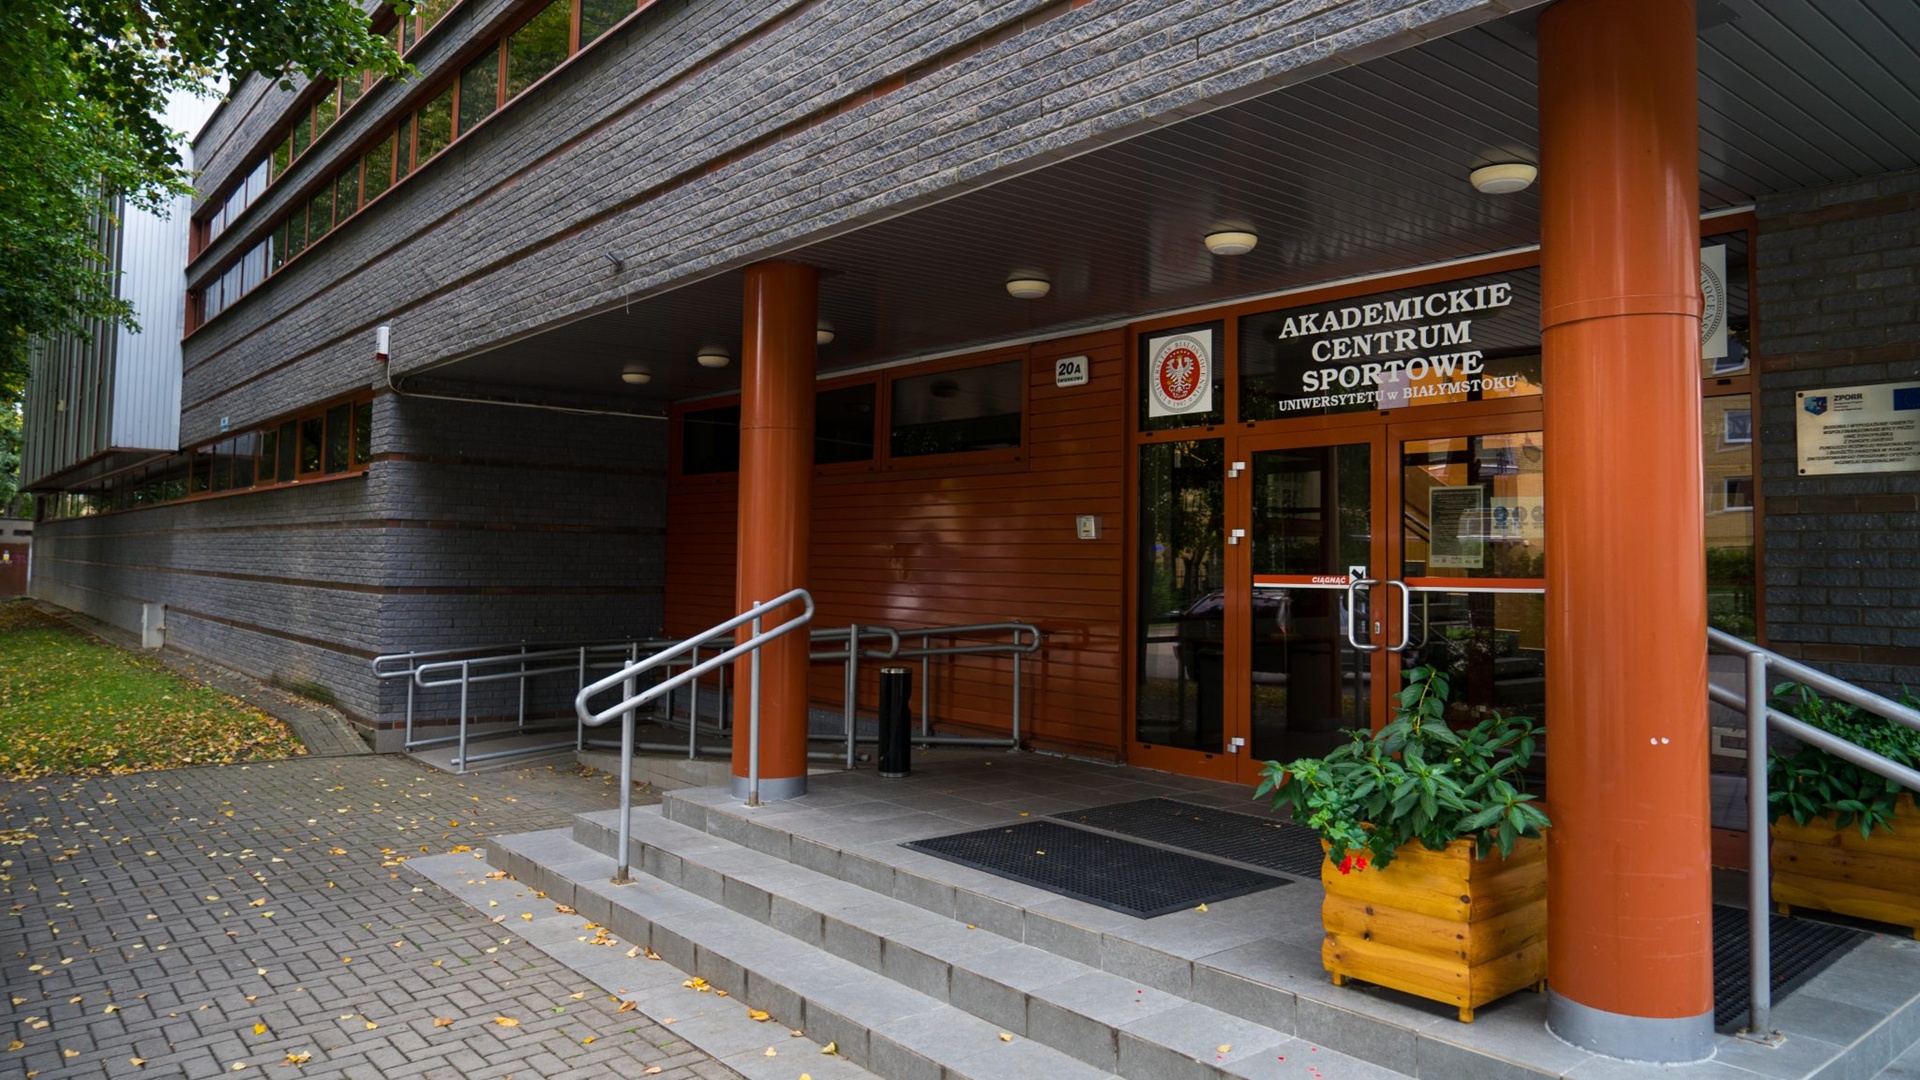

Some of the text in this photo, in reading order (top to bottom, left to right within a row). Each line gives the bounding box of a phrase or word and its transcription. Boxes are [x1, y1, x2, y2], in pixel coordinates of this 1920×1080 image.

[1278, 282, 1513, 340] AKADEMICKIE
[1312, 320, 1472, 362] CENTRUM
[1058, 362, 1081, 376] 20A
[1302, 350, 1485, 393] SPORTOWE
[1279, 375, 1517, 412] UNIWERSYTETU w BIAŁYMSTOKU
[1833, 393, 1863, 401] ZPORR
[1311, 575, 1347, 585] CIĄGNĄĆ
